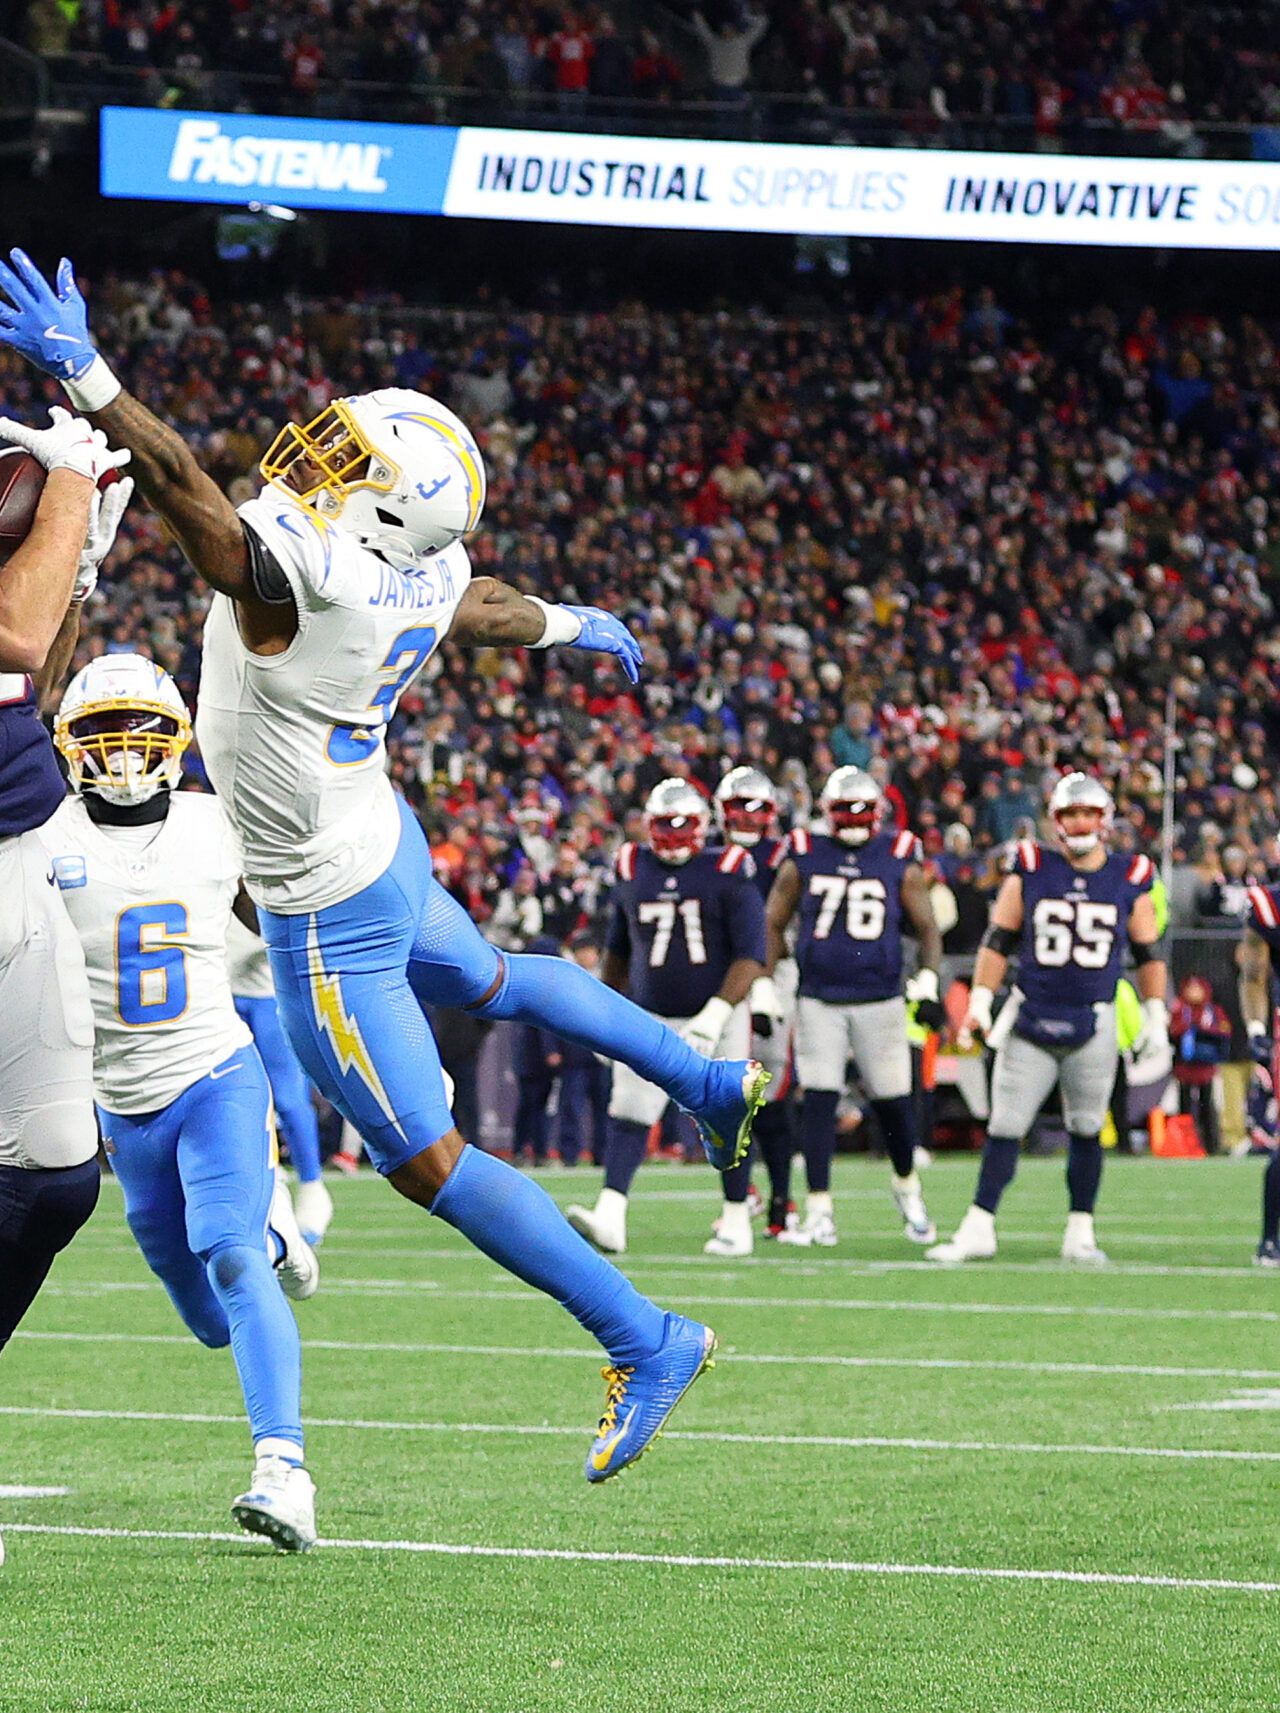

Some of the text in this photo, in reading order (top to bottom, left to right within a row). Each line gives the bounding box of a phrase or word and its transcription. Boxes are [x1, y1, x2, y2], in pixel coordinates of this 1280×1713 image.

[169, 118, 387, 194] FASTENAL
[478, 153, 710, 203] INDUSTRIAL
[728, 165, 908, 213] SUPPLIES
[944, 175, 1198, 220] INNOVATIVE
[368, 558, 456, 609] JAMES JR
[325, 622, 437, 768] 3
[637, 899, 708, 968] 71
[808, 874, 887, 941] 76
[1033, 898, 1119, 969] 65
[114, 899, 191, 1028] 6
